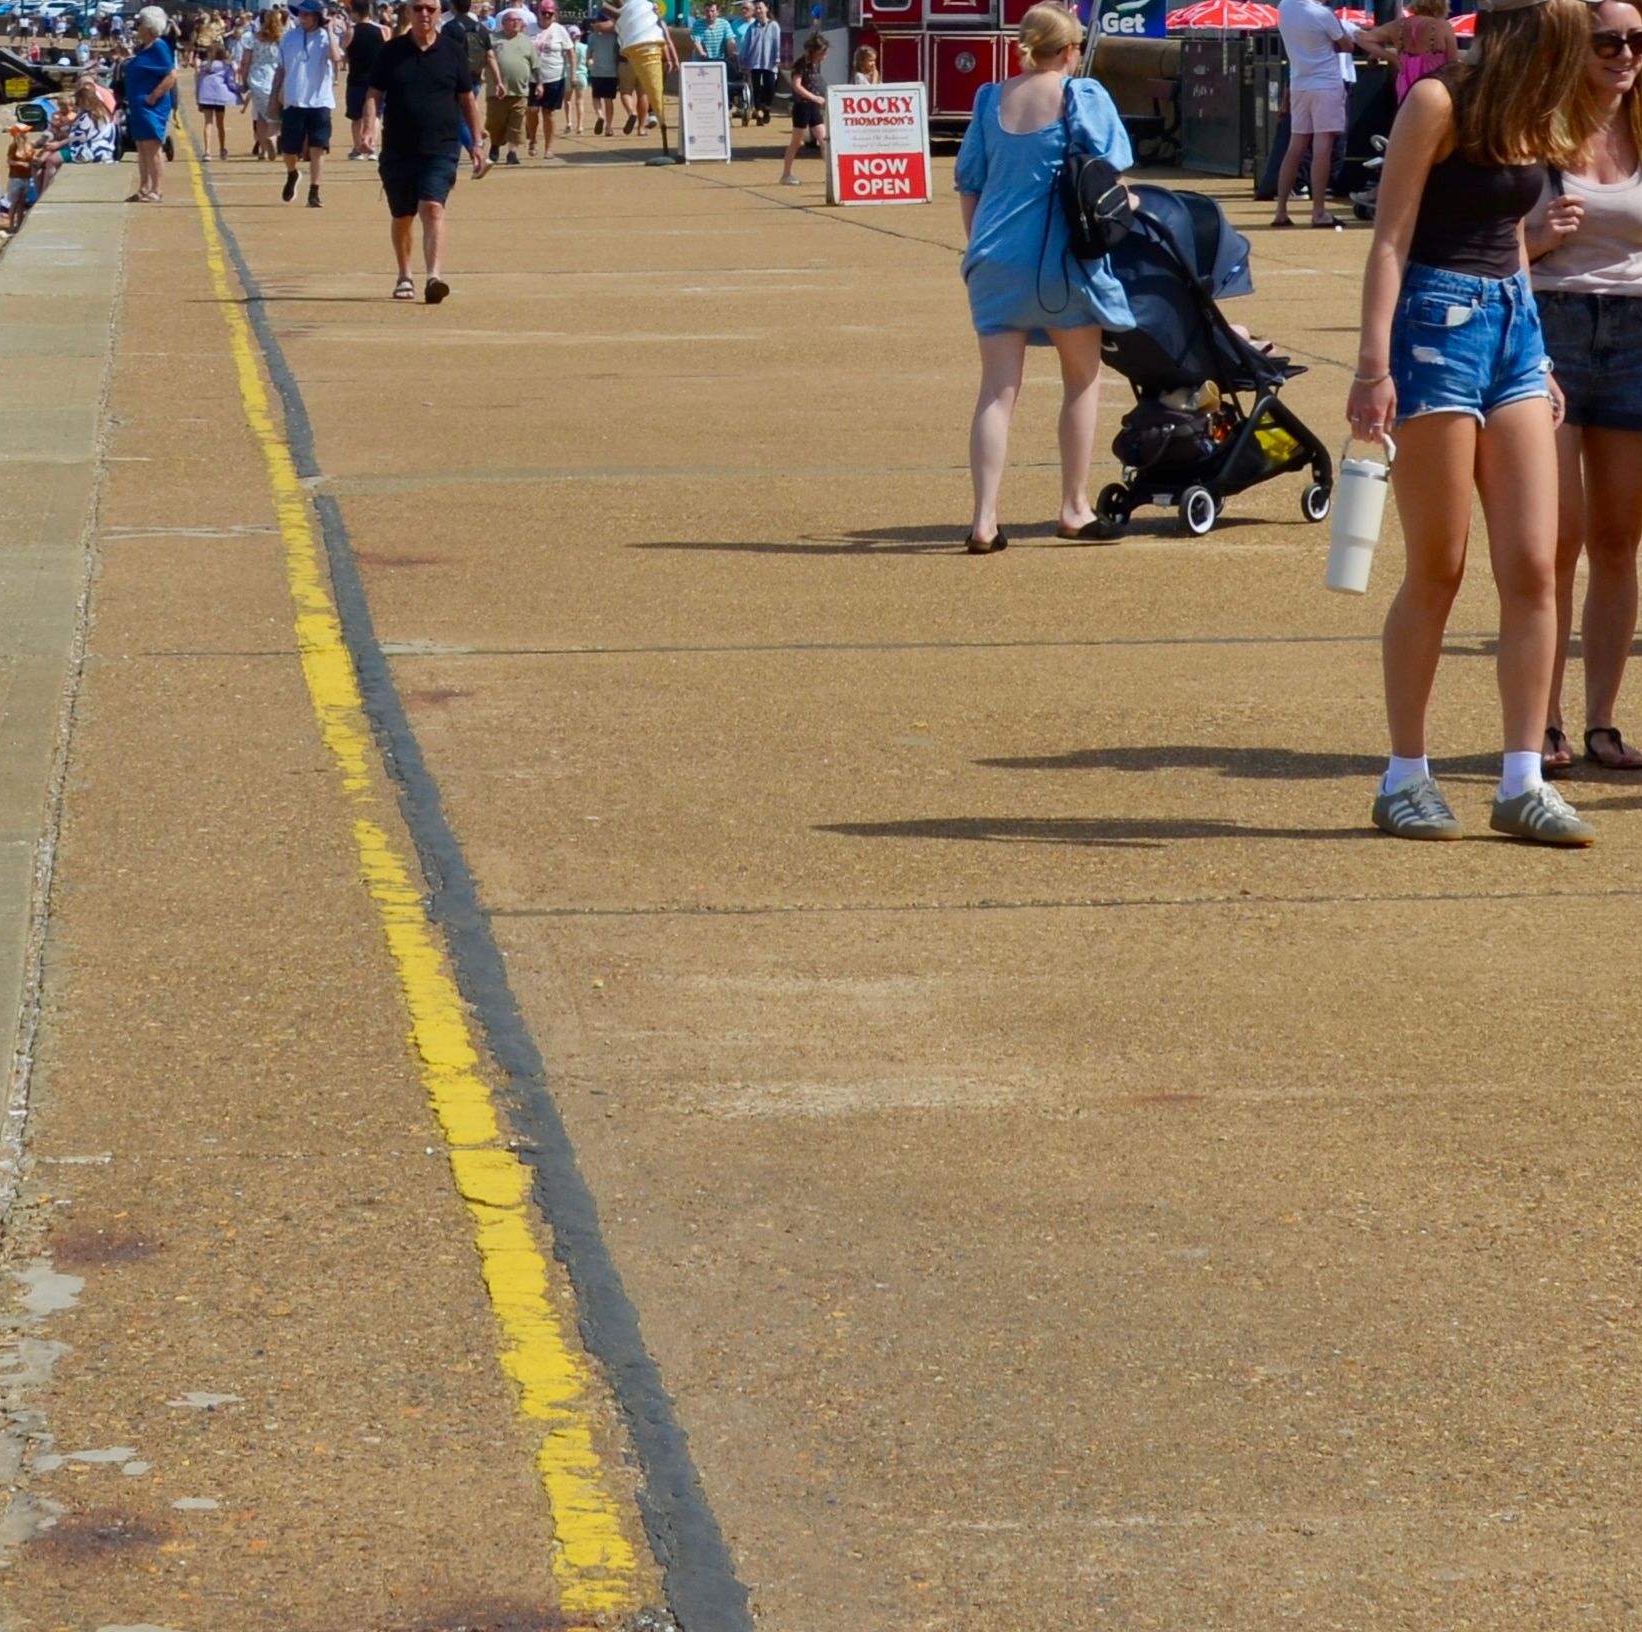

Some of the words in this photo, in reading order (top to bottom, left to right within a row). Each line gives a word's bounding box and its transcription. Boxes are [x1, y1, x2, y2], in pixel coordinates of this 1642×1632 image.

[1102, 12, 1145, 33] Get
[842, 96, 913, 114] ROCKY
[842, 115, 914, 126] THOMPSON'S
[853, 158, 908, 175] NOW
[853, 178, 911, 196] OPEN
